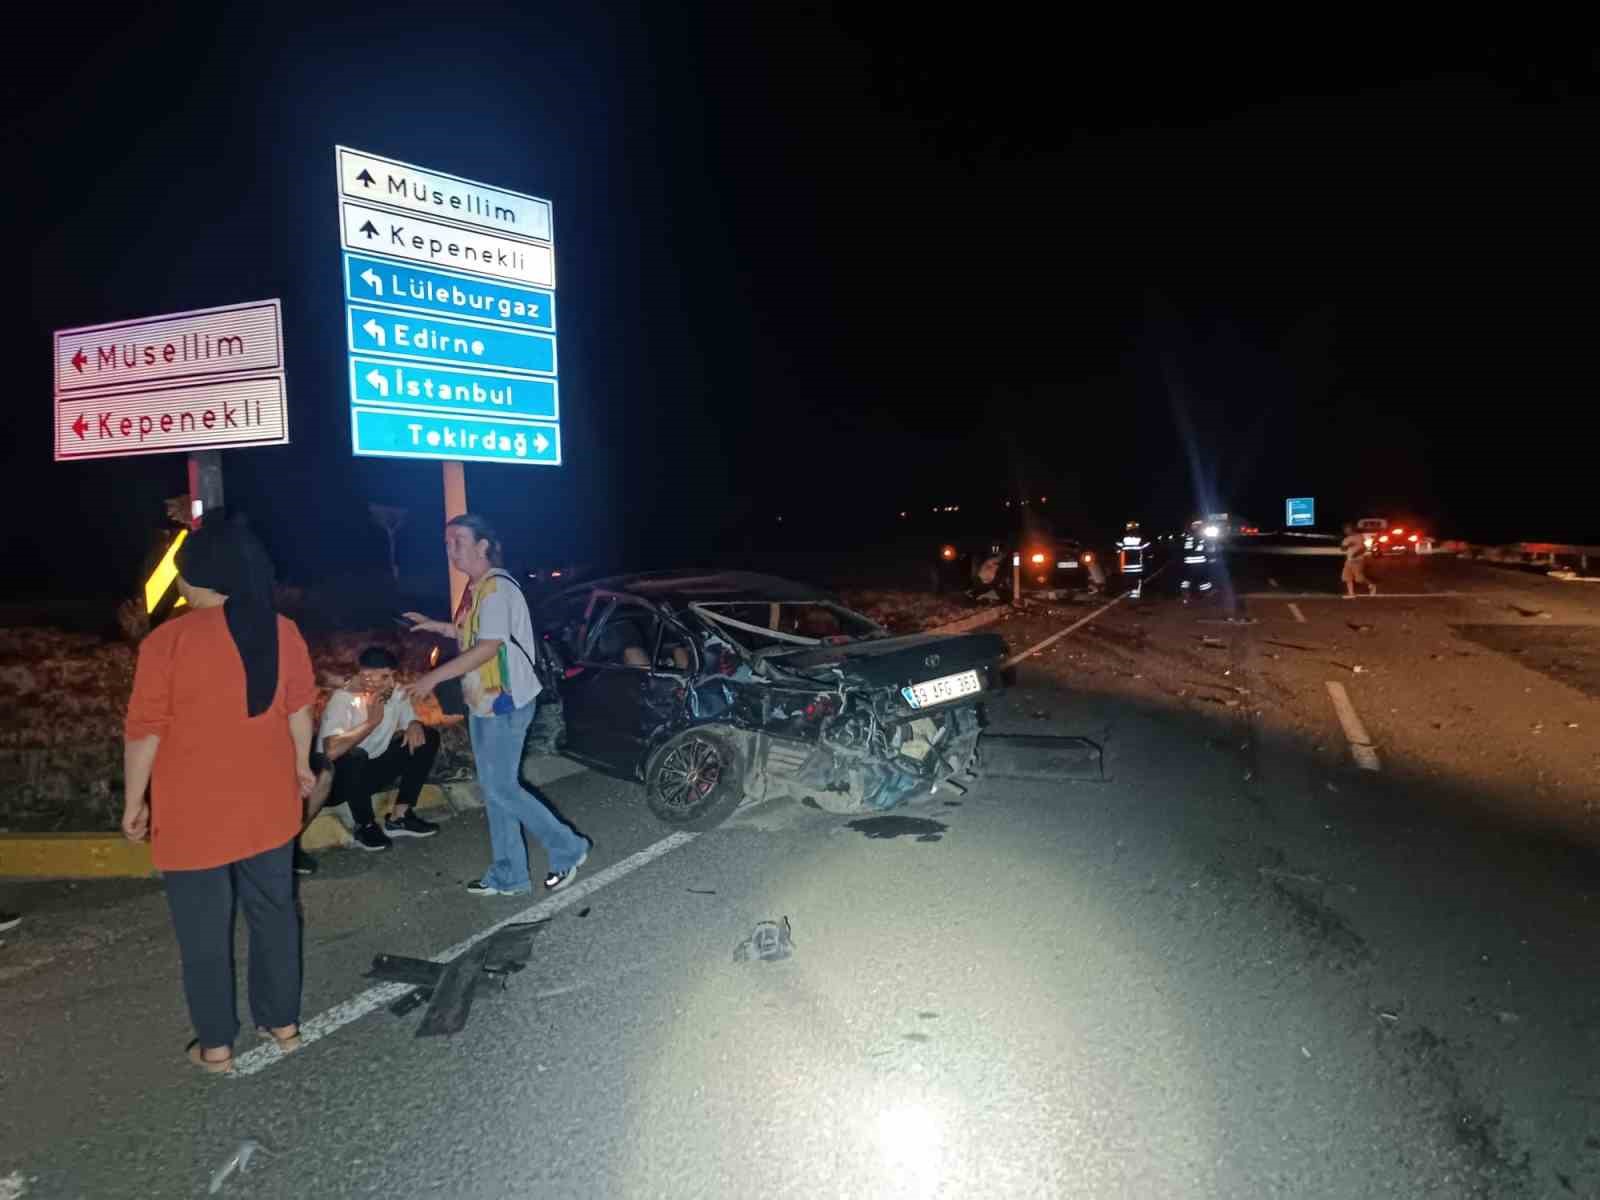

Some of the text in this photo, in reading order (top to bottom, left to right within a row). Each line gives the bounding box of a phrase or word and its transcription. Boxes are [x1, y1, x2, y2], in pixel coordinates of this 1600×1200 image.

[387, 175, 516, 224] Müsellim
[390, 224, 526, 270] Kepenekli
[391, 274, 540, 319] Lüleburgaz
[97, 333, 244, 371] Müsellim
[394, 324, 486, 357] Edirne
[395, 368, 514, 406] İstanbul
[97, 400, 262, 442] Kepenekli
[407, 424, 528, 457] Tekirdağ
